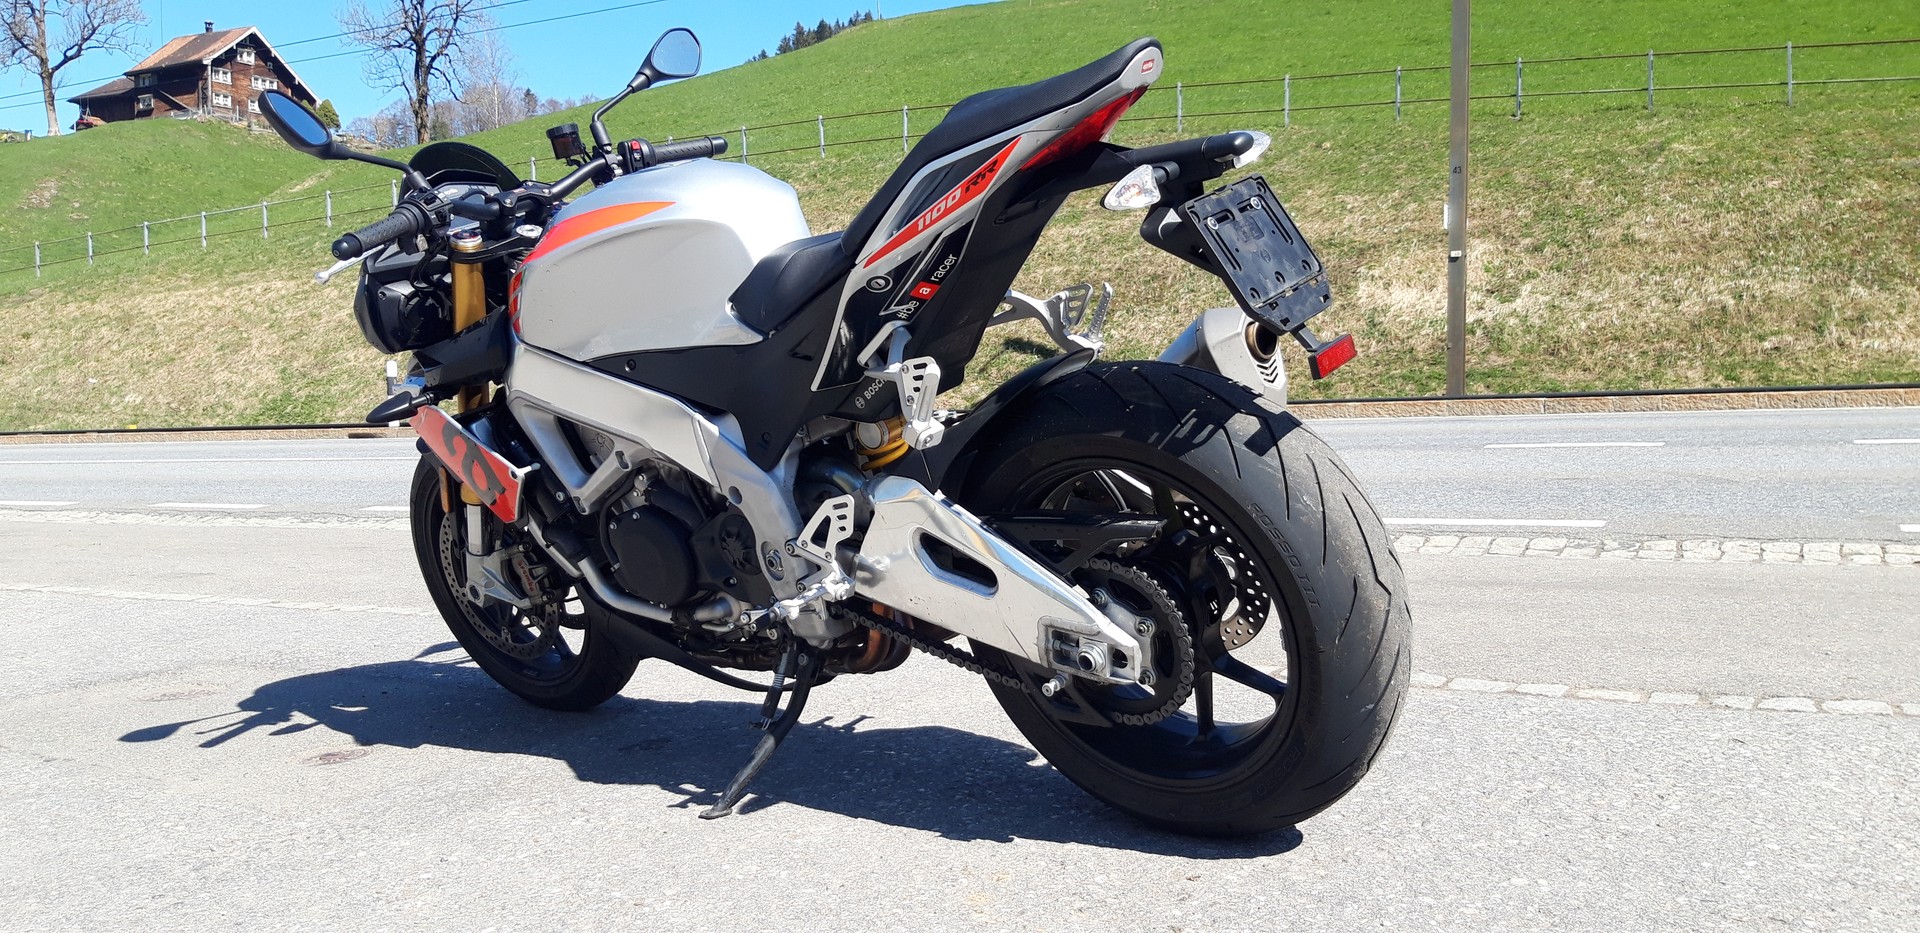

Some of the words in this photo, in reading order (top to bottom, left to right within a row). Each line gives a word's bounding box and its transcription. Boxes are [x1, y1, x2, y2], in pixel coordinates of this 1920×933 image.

[917, 188, 962, 231] 1100
[965, 157, 999, 193] RR
[1453, 166, 1462, 174] 43
[896, 300, 920, 320] #be
[919, 286, 931, 295] a
[930, 253, 958, 282] racer
[1248, 502, 1302, 568] ROSSO
